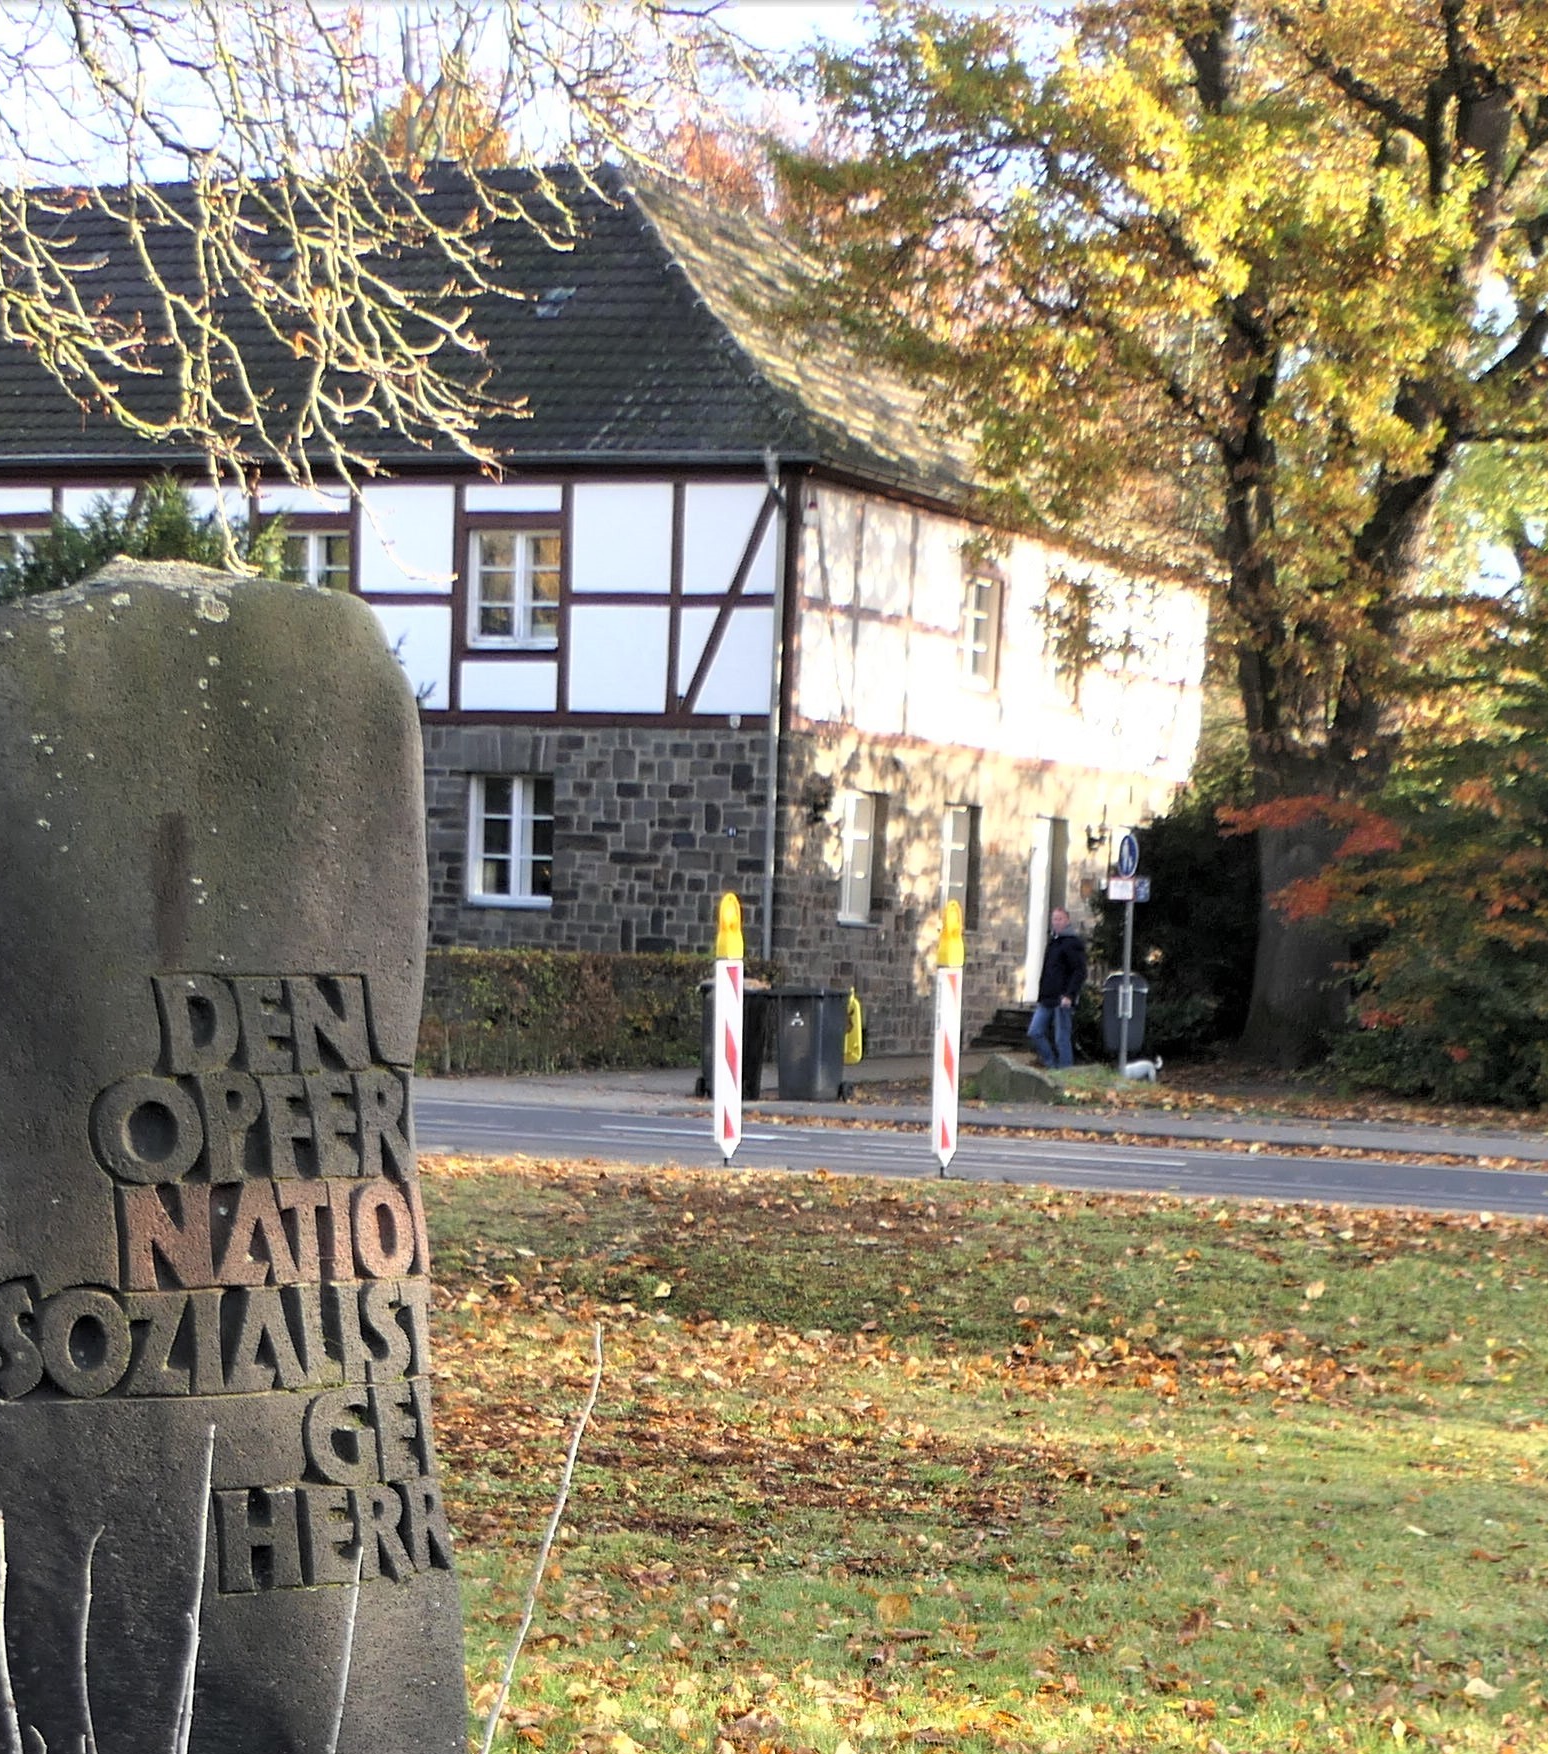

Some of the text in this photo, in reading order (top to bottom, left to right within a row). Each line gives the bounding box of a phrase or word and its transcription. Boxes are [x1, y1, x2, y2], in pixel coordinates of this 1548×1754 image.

[154, 973, 373, 1075] DEN
[90, 1068, 416, 1184] OPFER
[116, 1178, 417, 1291] NATIO
[214, 1479, 452, 1594] HERR
